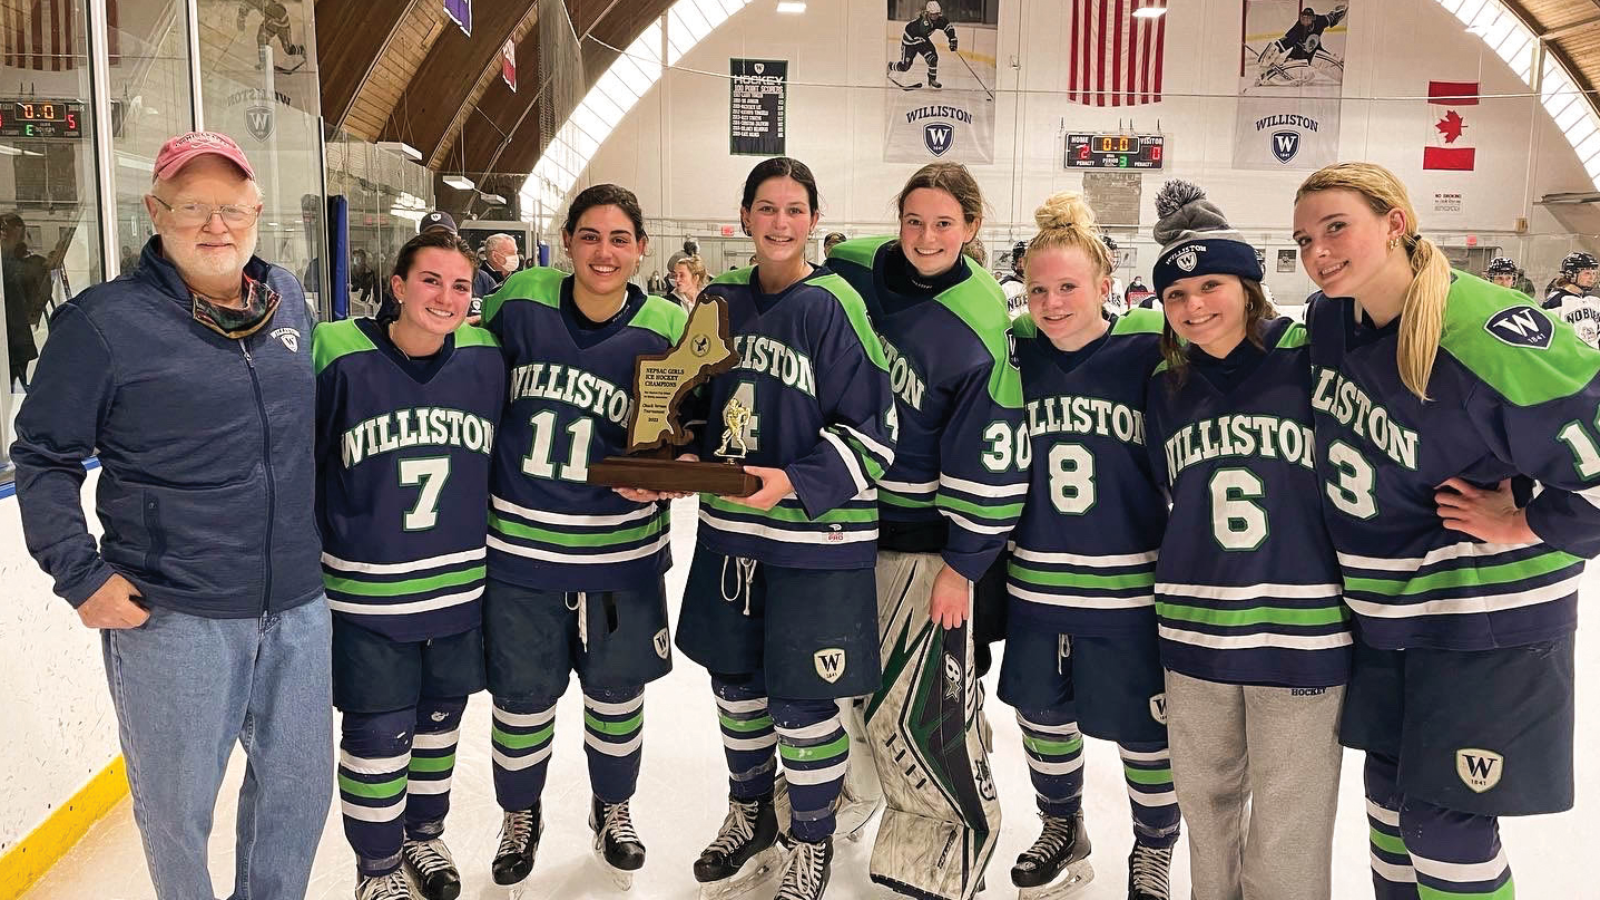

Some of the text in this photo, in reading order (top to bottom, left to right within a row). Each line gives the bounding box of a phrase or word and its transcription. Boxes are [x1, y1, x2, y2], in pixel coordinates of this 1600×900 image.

[734, 75, 783, 85] HOCKEY
[906, 106, 972, 124] WILLISTON
[1255, 114, 1318, 132] WILLISTON
[927, 128, 951, 145] W
[1102, 137, 1128, 151] 0.0
[1140, 137, 1163, 145] VISITOR
[1274, 135, 1297, 152] W
[1120, 155, 1127, 167] 3
[1152, 146, 1161, 160] 0
[1181, 255, 1193, 265] W
[1492, 308, 1540, 337] W
[1527, 332, 1546, 344] 1841
[522, 410, 594, 482] 11
[981, 422, 1032, 472] 30
[1559, 422, 1600, 478] 1
[1048, 444, 1095, 513] 8
[1326, 442, 1376, 519] 3
[400, 457, 450, 530] 7
[1209, 469, 1268, 549] 6
[818, 653, 842, 672] W
[1461, 754, 1498, 779] W
